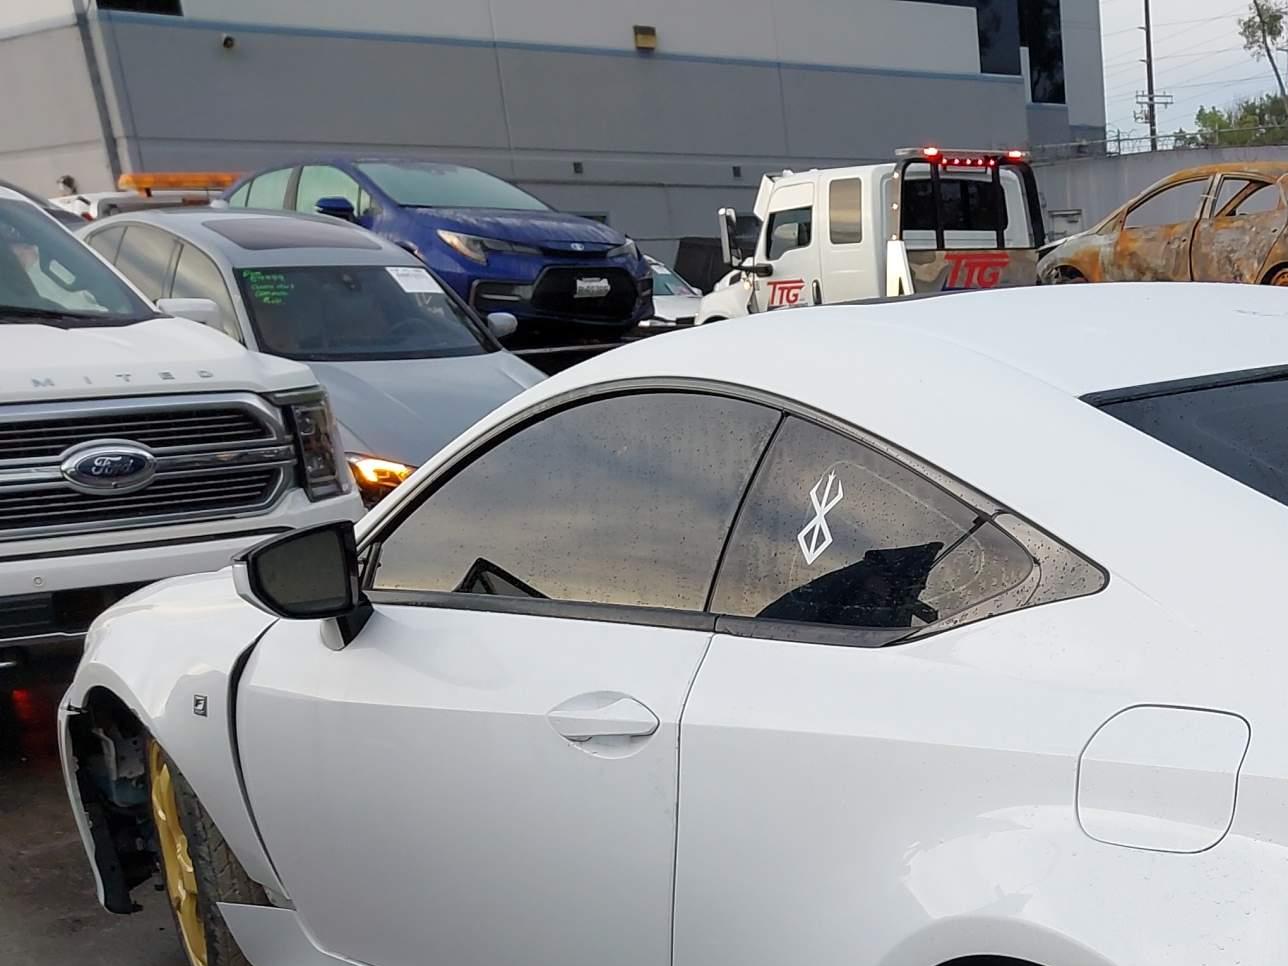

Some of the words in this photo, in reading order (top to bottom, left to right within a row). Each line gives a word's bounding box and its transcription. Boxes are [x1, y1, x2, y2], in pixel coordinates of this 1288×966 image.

[943, 251, 1008, 290] TTG
[766, 279, 803, 306] TTG
[91, 455, 134, 475] Ford
